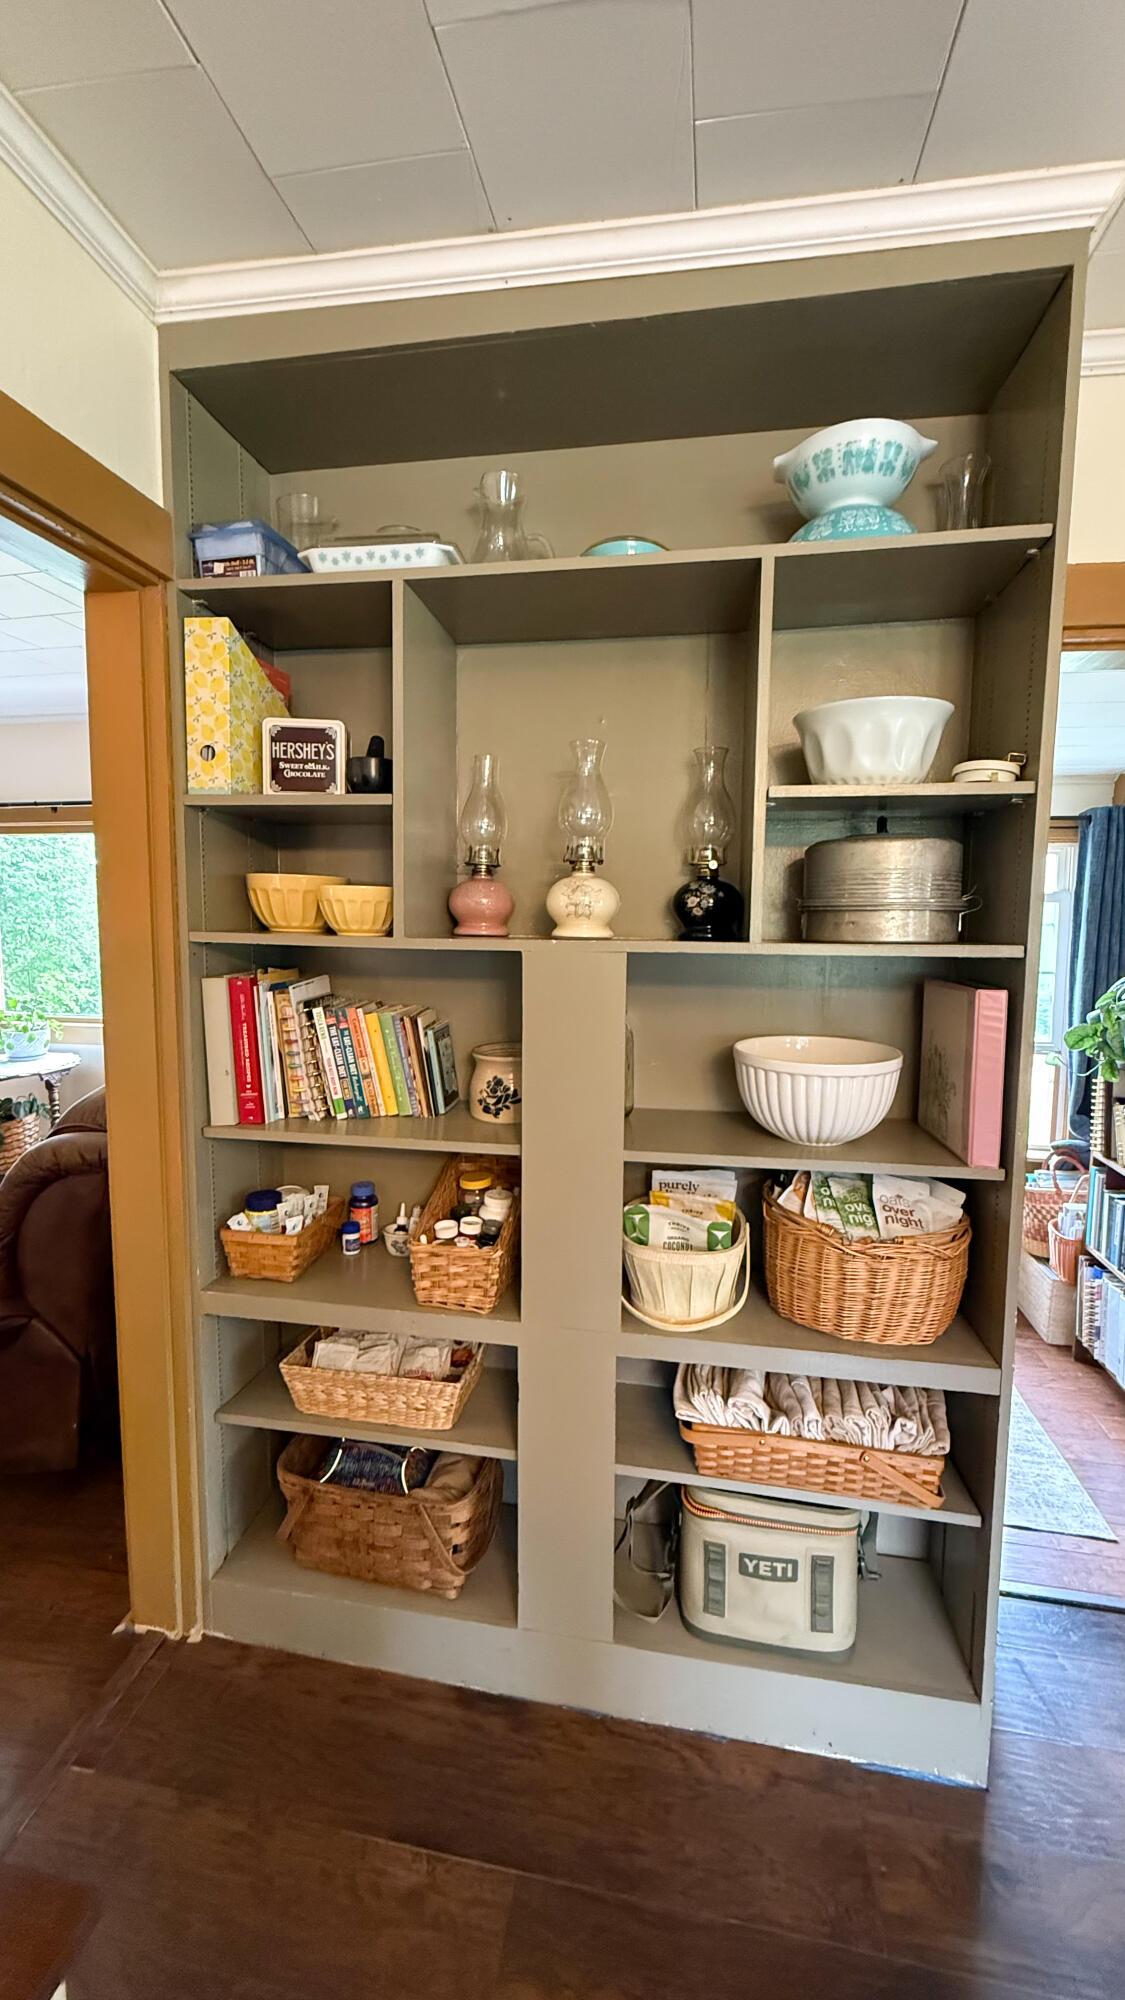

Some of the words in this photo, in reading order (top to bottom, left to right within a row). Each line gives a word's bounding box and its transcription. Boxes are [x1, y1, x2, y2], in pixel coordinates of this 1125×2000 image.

[271, 741, 335, 760] HERSHEY'S
[278, 761, 304, 770] SWEET
[283, 769, 326, 778] CHOCOLATE
[328, 1025, 338, 1037] THE
[331, 1036, 345, 1066] EAT-CLEAN
[343, 1036, 356, 1064] EAT-CLEAN
[337, 1064, 347, 1078] DIET
[349, 1063, 358, 1075] DIET
[658, 1180, 700, 1193] purely
[880, 1194, 910, 1208] oats
[882, 1204, 915, 1217] over
[884, 1214, 924, 1229] night
[662, 1241, 693, 1251] COCONUT
[743, 1557, 793, 1578] YETI
